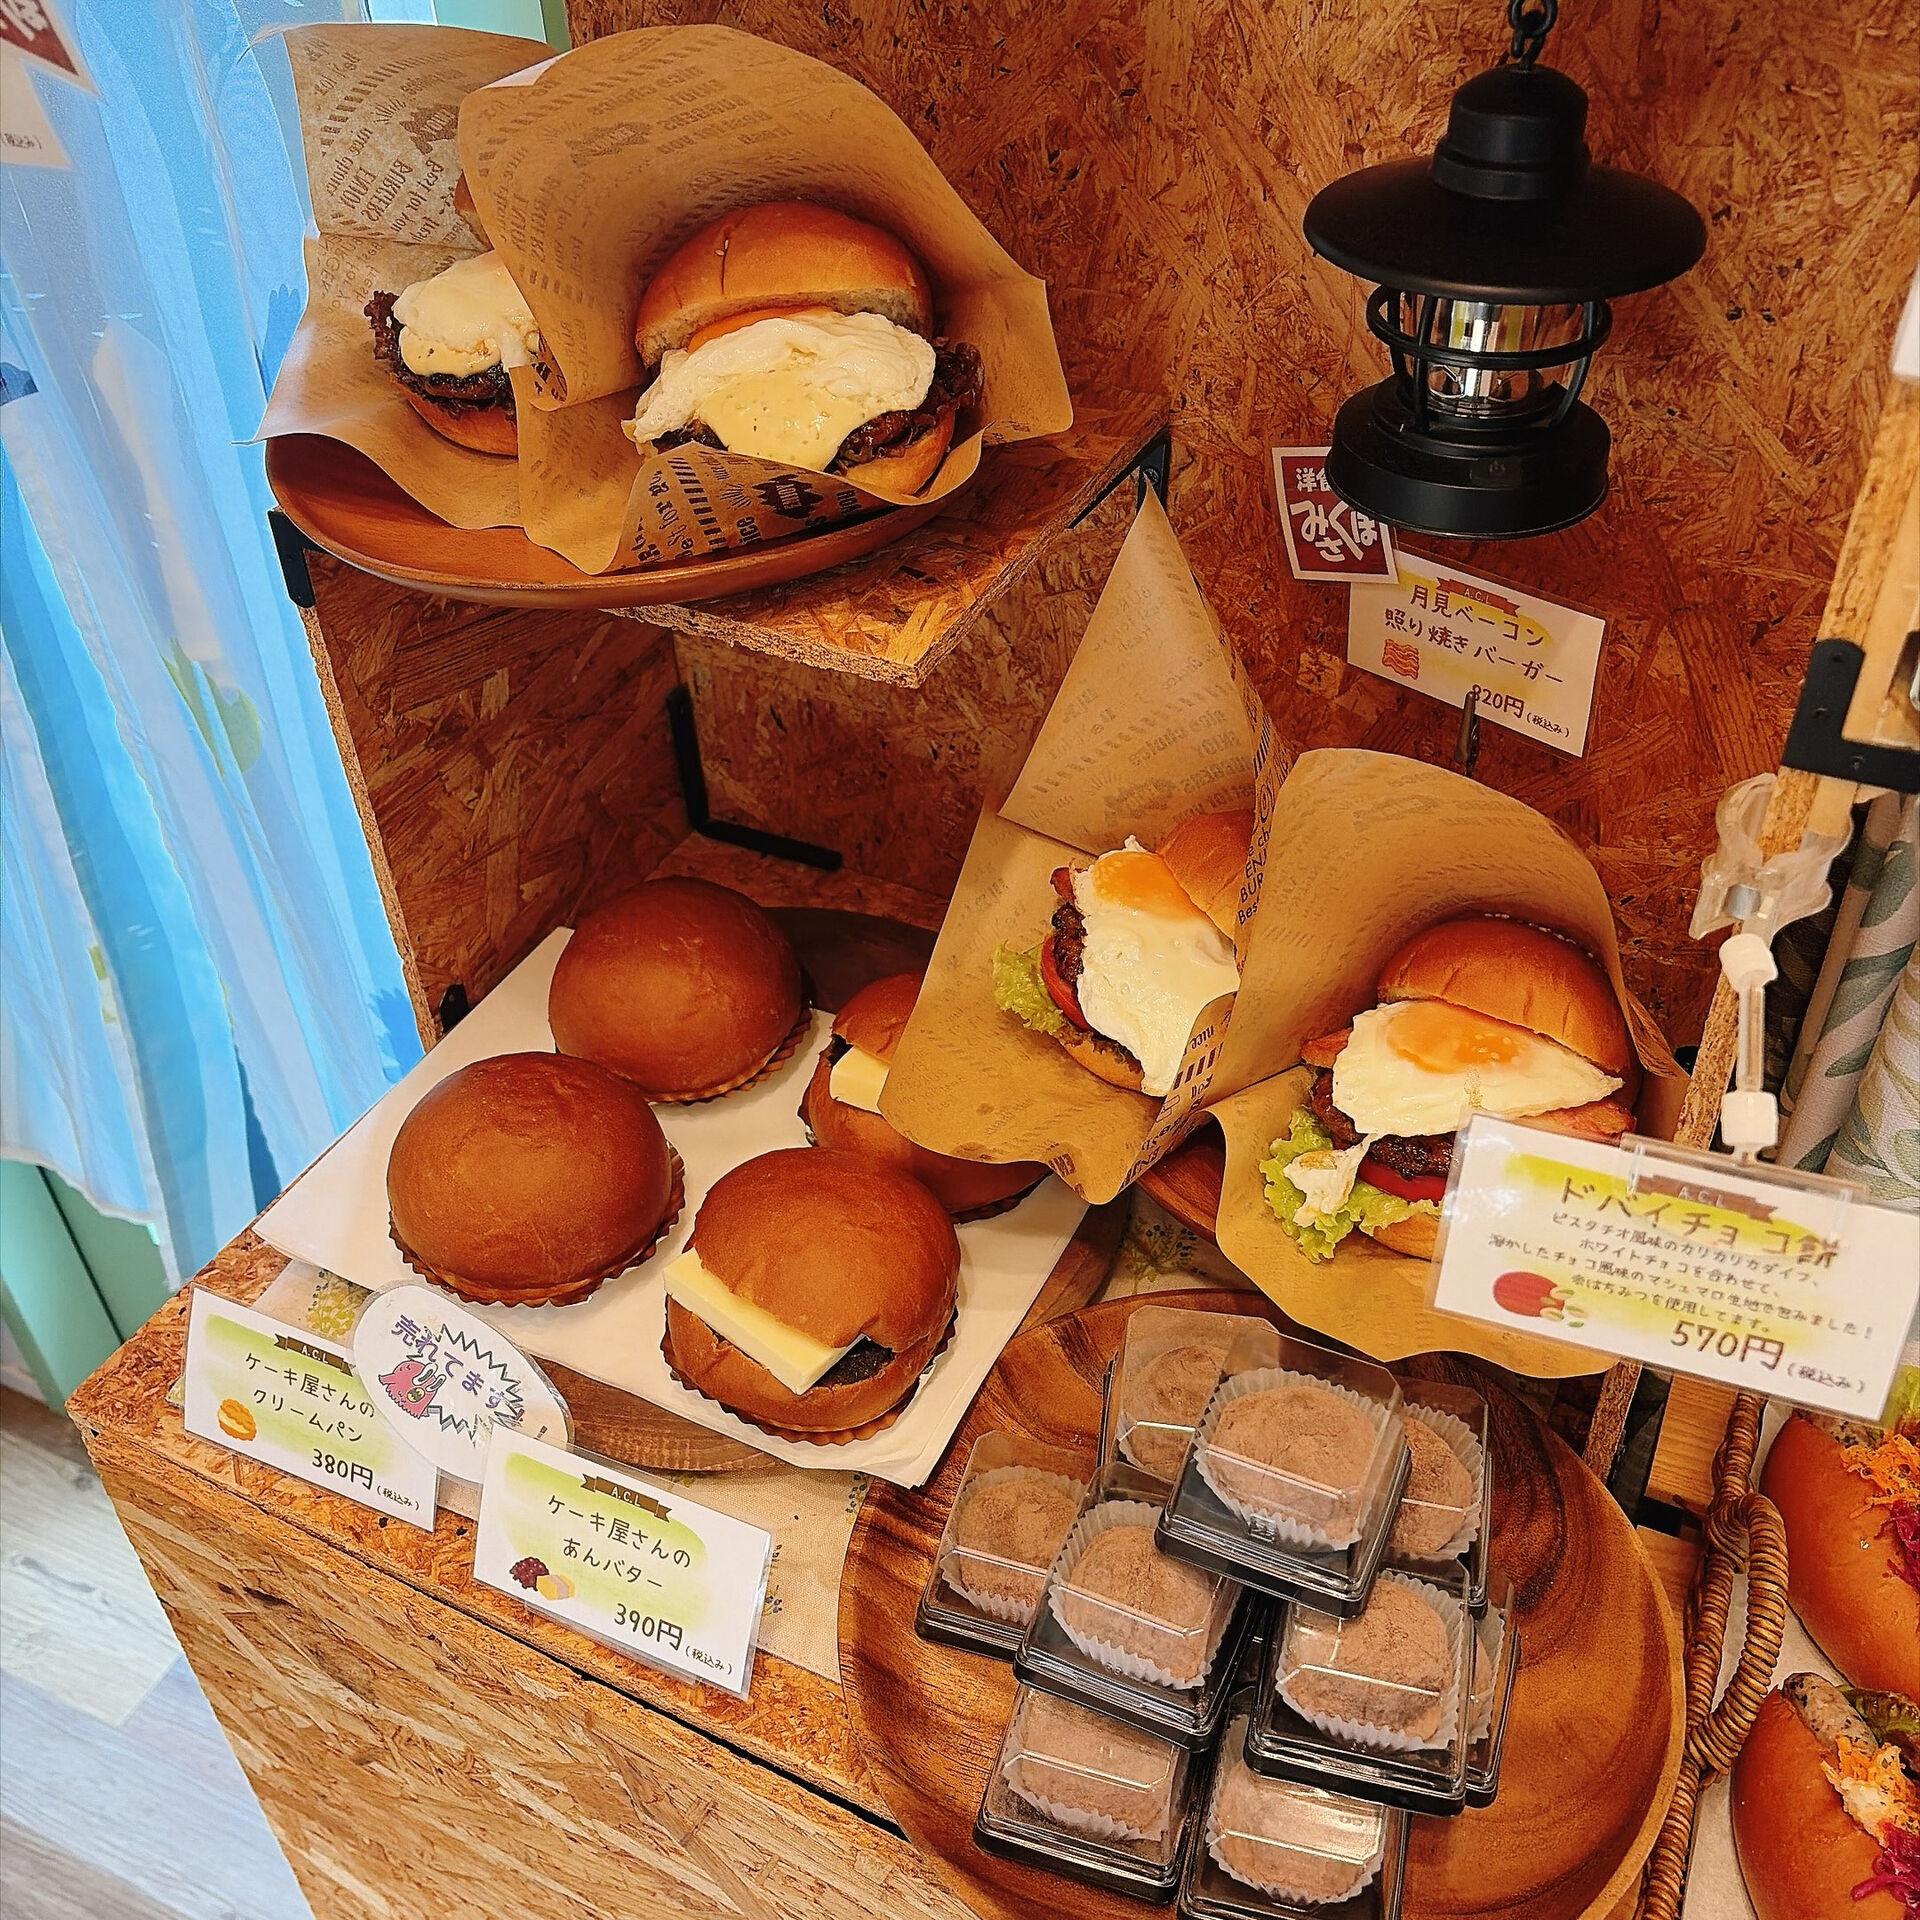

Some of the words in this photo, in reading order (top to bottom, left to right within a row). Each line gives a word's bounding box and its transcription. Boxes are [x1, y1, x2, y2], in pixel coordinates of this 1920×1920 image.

[1384, 608, 1564, 684] 照り焼きバーガー
[1410, 584, 1545, 648] 月見ベーコン
[1560, 1176, 1841, 1269] ドバイチョコ餅
[1670, 1320, 1785, 1370] 570円
[245, 1352, 375, 1419] ケーキ屋さんの
[253, 1389, 362, 1443] クリームパン
[311, 1448, 375, 1490] 380円
[375, 1483, 420, 1513] (税込み)
[611, 1484, 642, 1507] A.C.L
[548, 1494, 691, 1568] ケーキ屋さんの
[563, 1537, 663, 1588] あんバター
[614, 1603, 683, 1651] 390円
[685, 1645, 733, 1676] (税込み)
